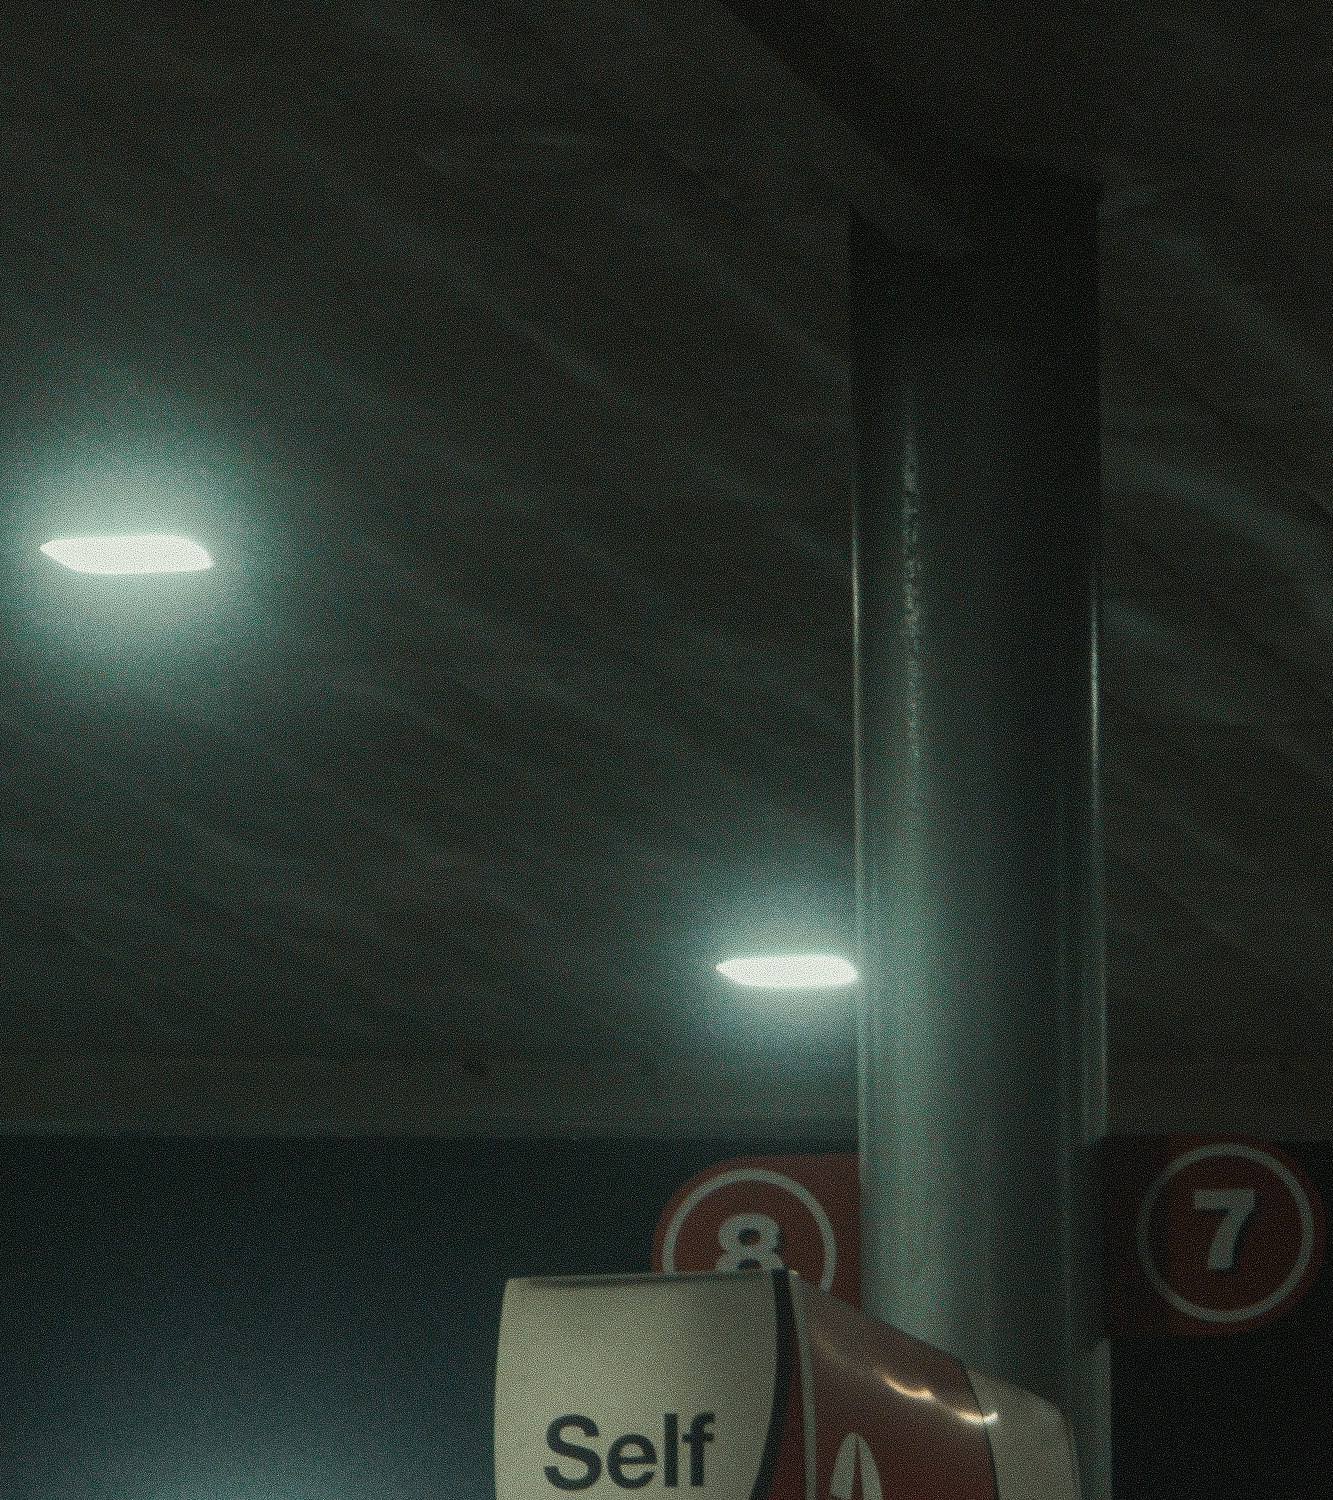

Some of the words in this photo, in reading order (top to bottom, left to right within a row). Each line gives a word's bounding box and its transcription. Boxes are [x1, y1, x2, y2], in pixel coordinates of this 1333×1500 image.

[716, 1213, 782, 1270] 8
[1193, 1187, 1258, 1271] 7
[543, 1412, 715, 1491] Self
